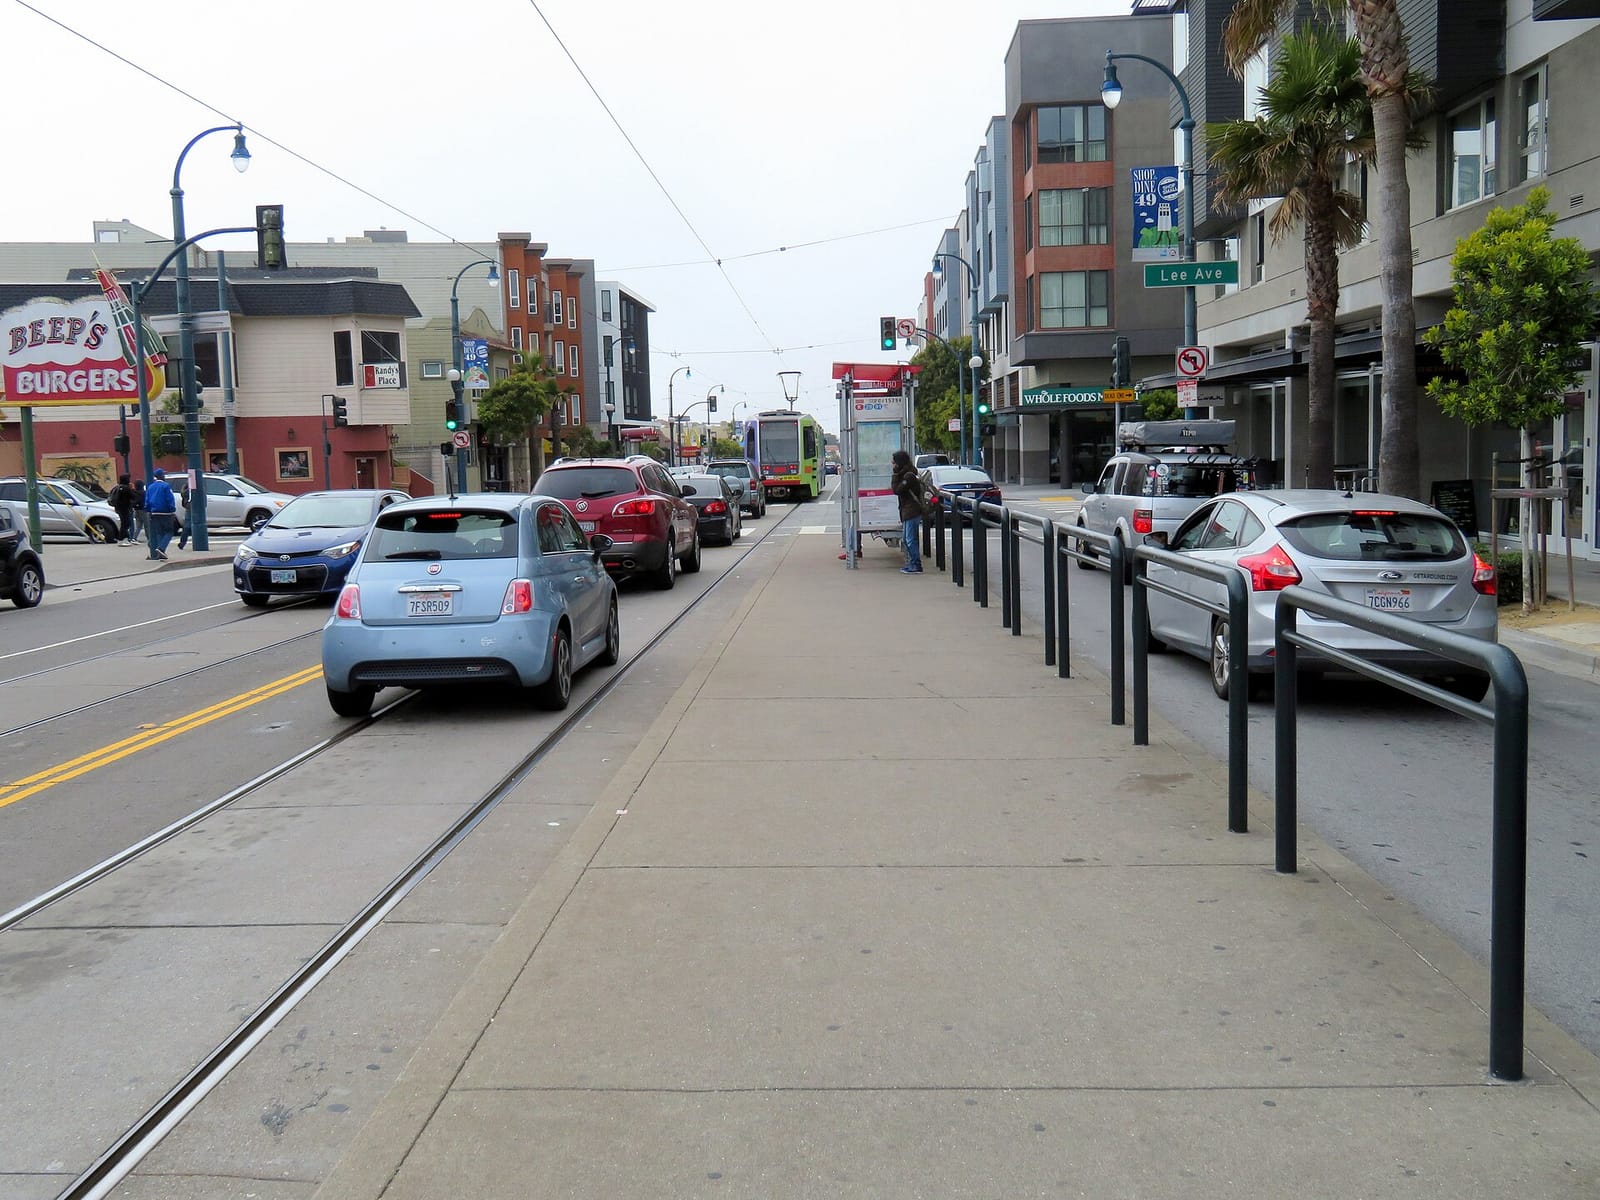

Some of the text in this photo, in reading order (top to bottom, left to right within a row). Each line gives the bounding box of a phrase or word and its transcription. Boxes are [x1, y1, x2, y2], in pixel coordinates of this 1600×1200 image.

[1133, 169, 1155, 180] SHOP
[1134, 180, 1156, 193] DINE
[1134, 193, 1157, 206] 49
[1160, 268, 1222, 281] Lee Ave
[8, 310, 109, 355] BEEP'S
[375, 366, 399, 376] Randy's
[16, 368, 138, 395] BURGERS
[378, 377, 397, 385] Place
[1024, 390, 1062, 404] WHOLE
[1063, 392, 1096, 403] FOODS
[409, 600, 450, 613] 7FSR509
[1368, 596, 1410, 608] 7CGN966
